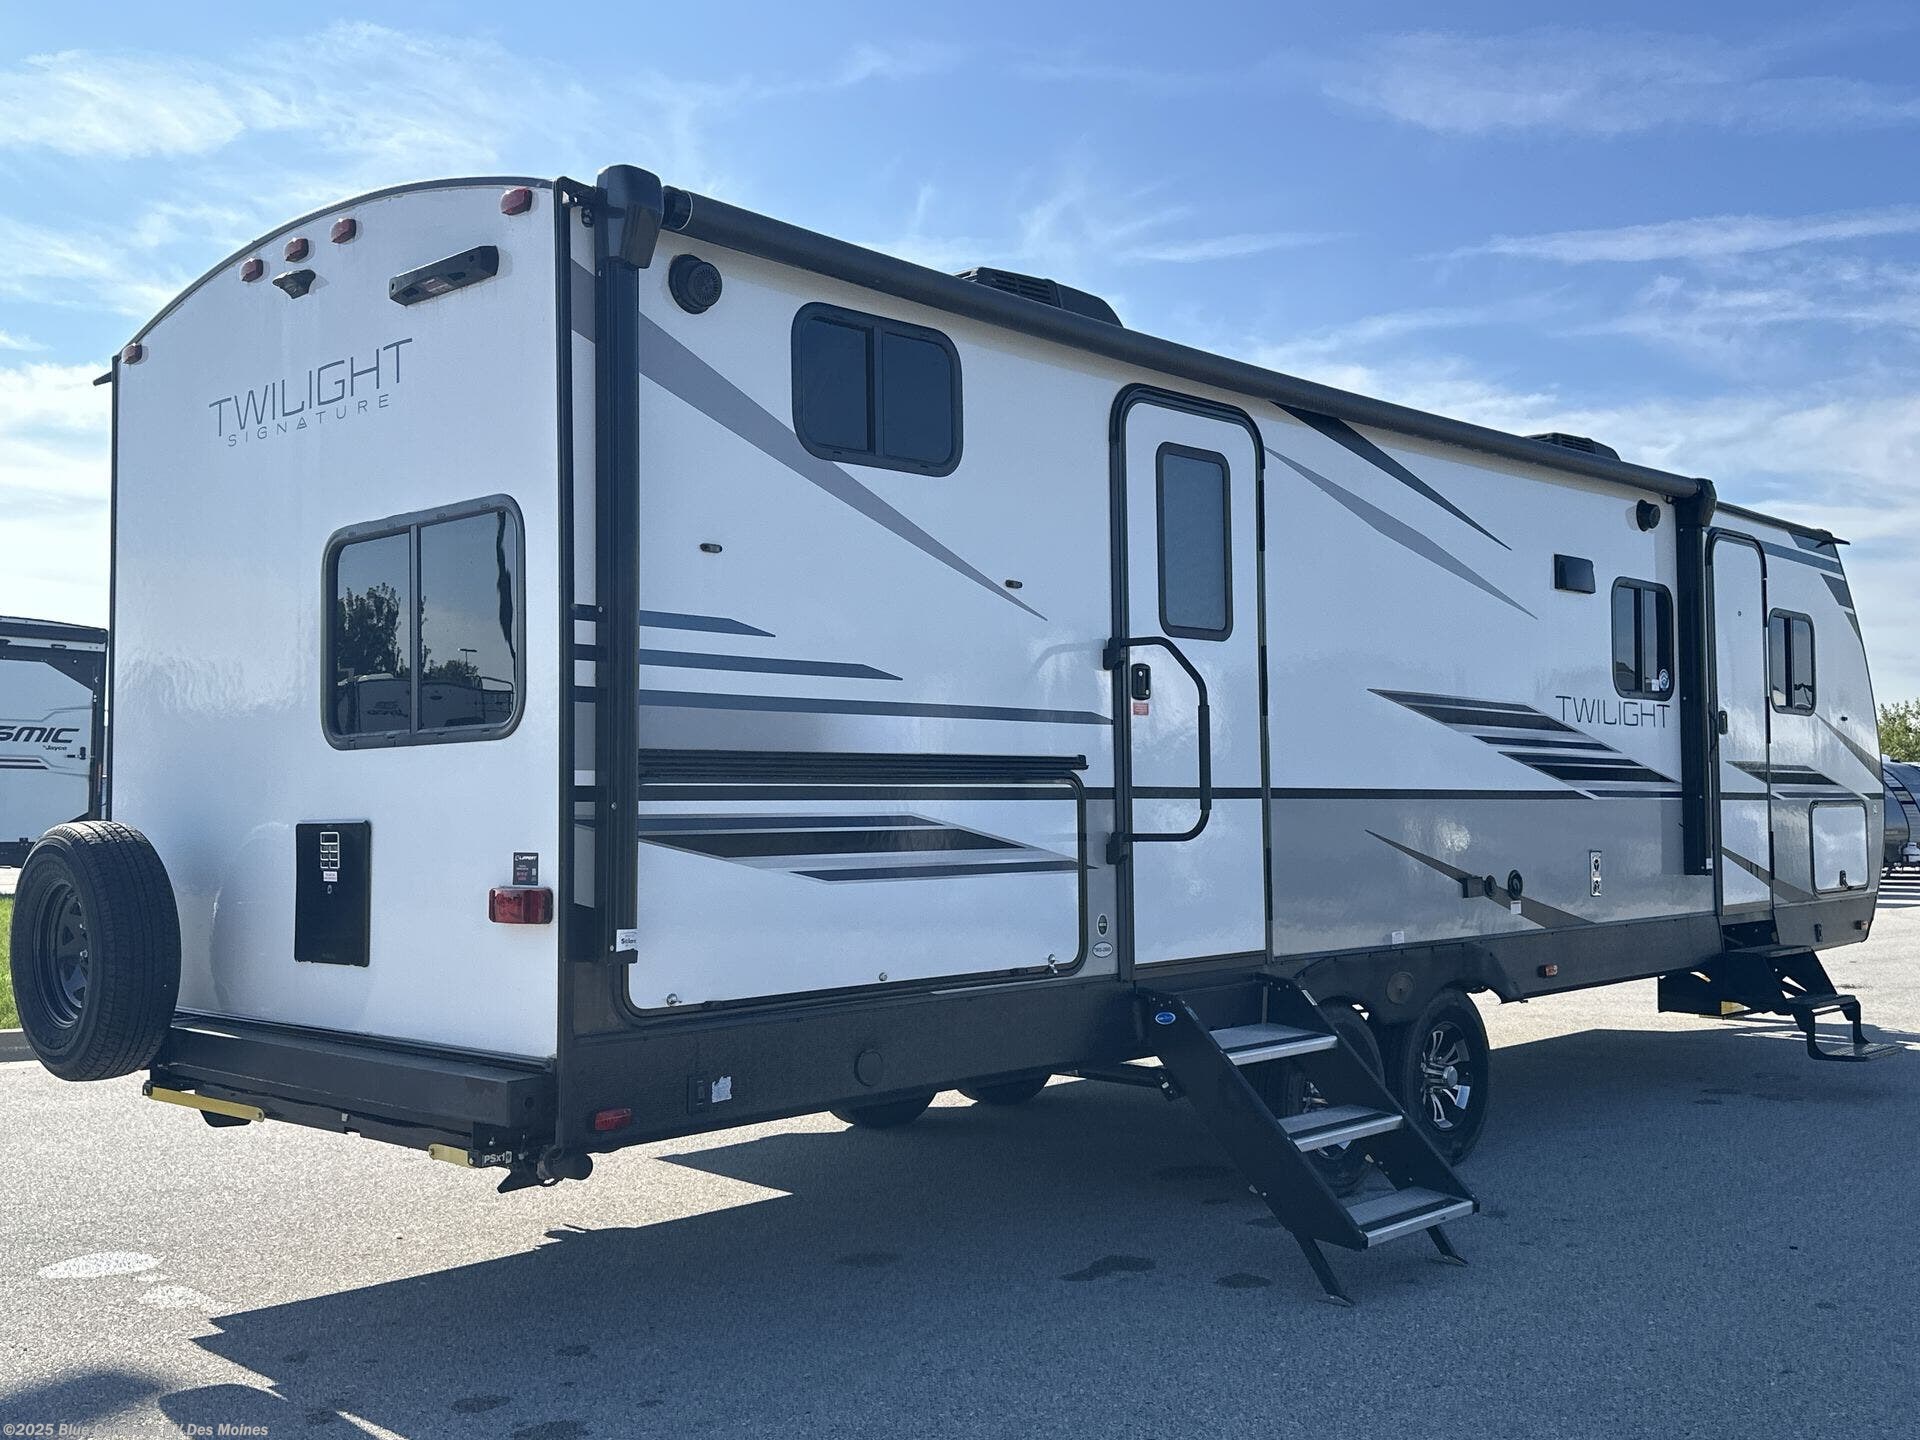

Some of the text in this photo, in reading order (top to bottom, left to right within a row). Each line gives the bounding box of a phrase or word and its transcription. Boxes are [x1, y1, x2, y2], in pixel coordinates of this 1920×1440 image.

[208, 337, 413, 437] TWILIGHT
[227, 394, 390, 447] SIGNATURE
[1555, 695, 1671, 728] TWILIGHT
